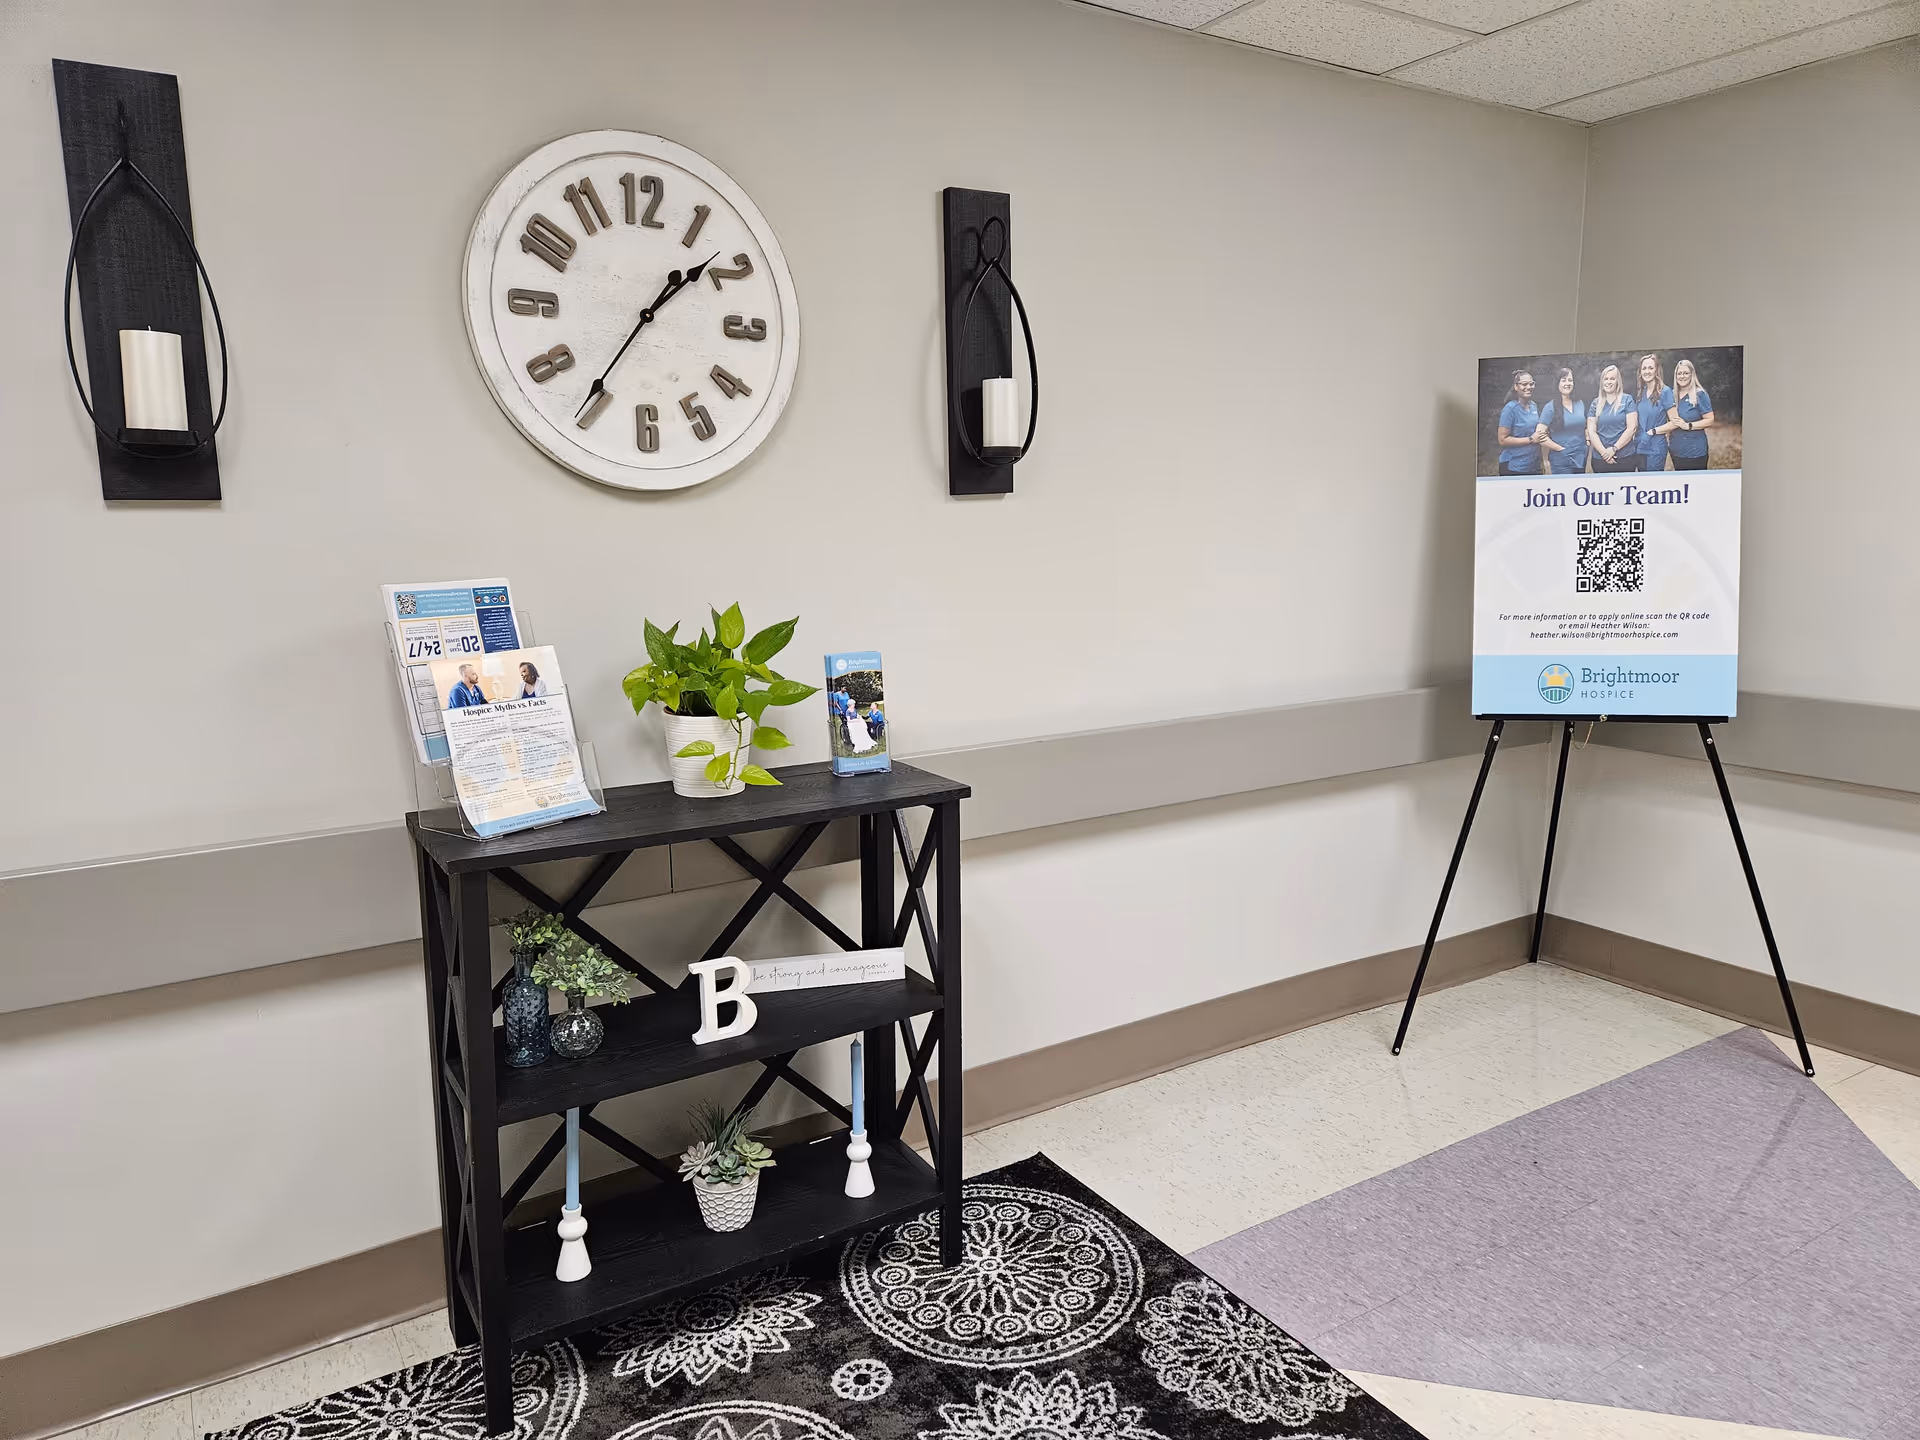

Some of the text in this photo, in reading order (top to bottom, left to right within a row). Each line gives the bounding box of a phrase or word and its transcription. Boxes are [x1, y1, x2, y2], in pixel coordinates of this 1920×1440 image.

[563, 176, 613, 236] 11
[619, 172, 665, 229] 12
[681, 204, 712, 248] 1
[519, 212, 578, 273] 10
[707, 252, 755, 292] 2
[507, 287, 560, 318] 9
[722, 314, 767, 342] 3
[526, 343, 576, 384] 8
[709, 364, 753, 399] 4
[576, 386, 614, 430] 7
[679, 391, 717, 441] 5
[635, 403, 660, 453] 6
[1523, 483, 1690, 508] Join Our Team!
[1533, 612, 1577, 622] information
[1598, 612, 1619, 622] apply
[1620, 612, 1644, 620] online
[1679, 612, 1690, 620] QR
[1622, 621, 1650, 629] Wilson:
[409, 640, 442, 658] 24/7
[461, 635, 481, 653] 20
[1530, 630, 1679, 641] heather.wilson@brightmoorhospice.com
[1580, 666, 1680, 686] Brightmoor
[462, 699, 547, 717] Hospice: Myths vs. Facts
[1580, 690, 1635, 699] HOSPICE
[753, 962, 889, 986] be strong and courageous
[688, 956, 758, 1046] B
